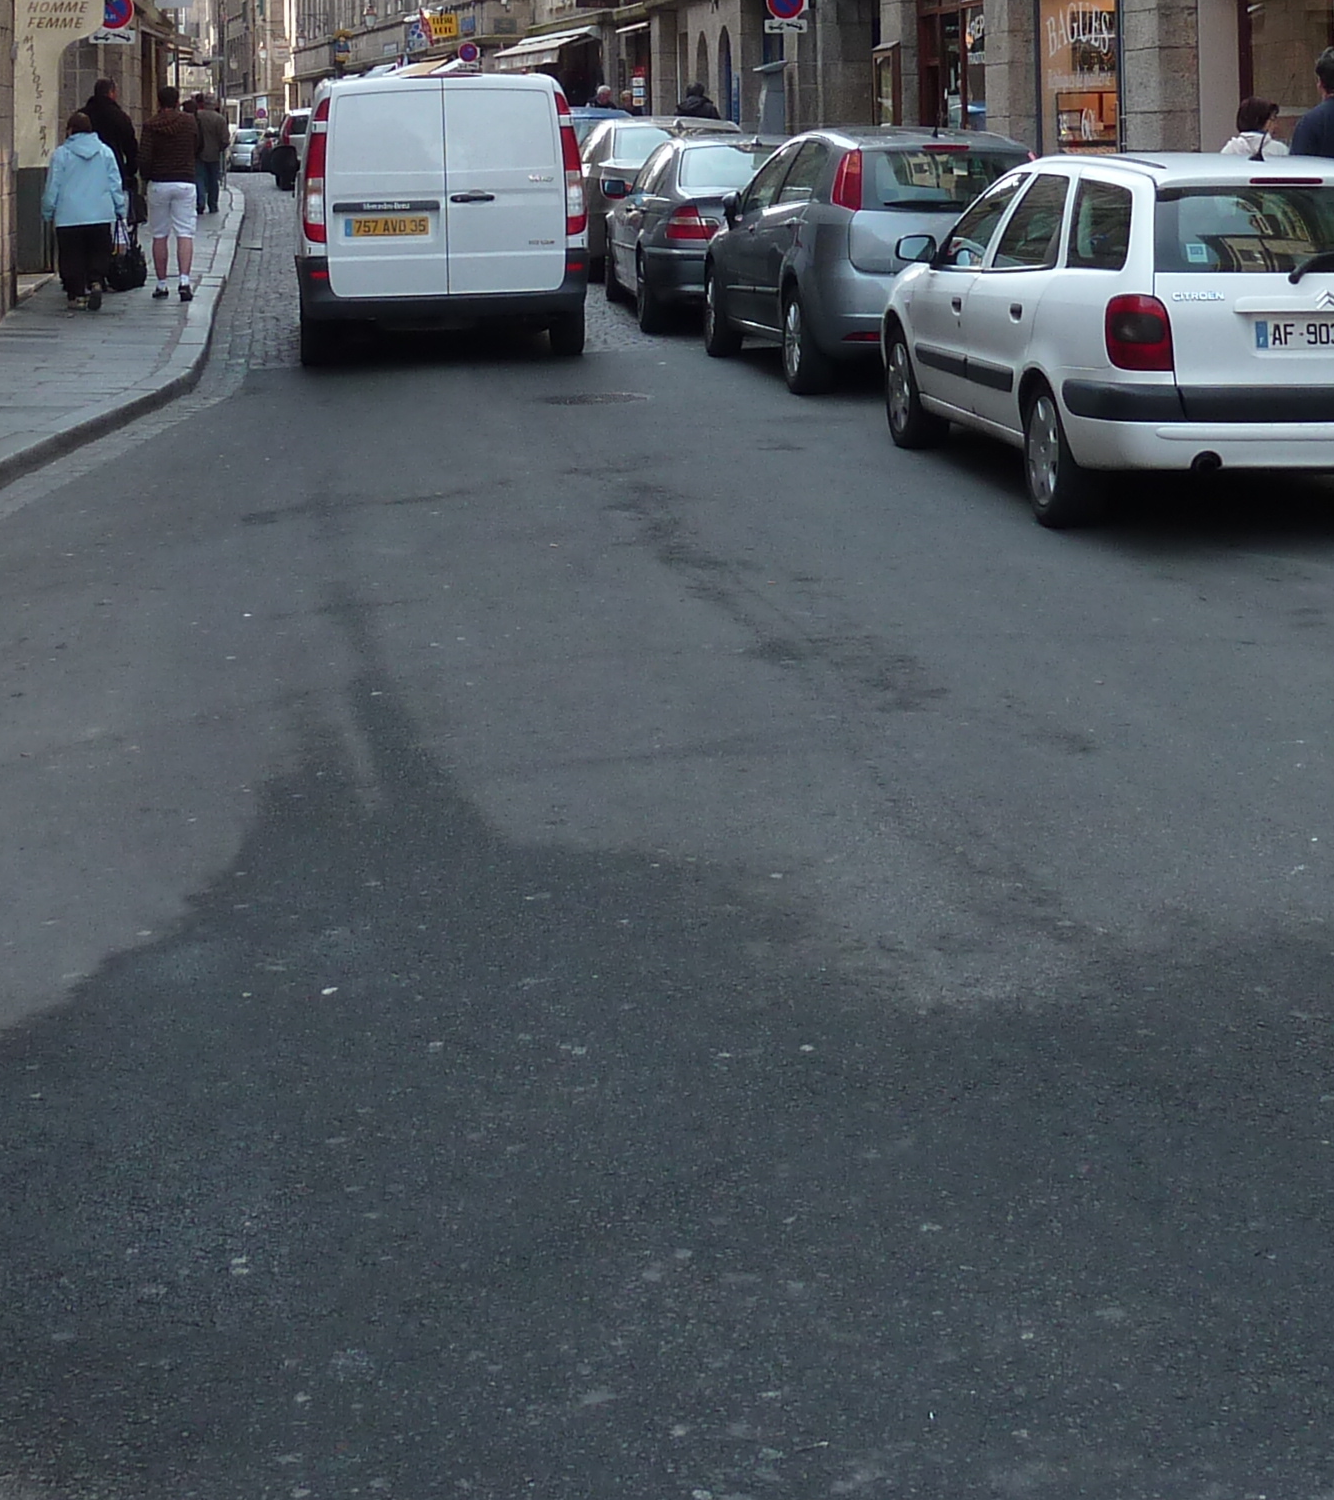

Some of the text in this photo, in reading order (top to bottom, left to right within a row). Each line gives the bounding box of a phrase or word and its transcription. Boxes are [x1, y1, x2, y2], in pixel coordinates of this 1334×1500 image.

[28, 1, 89, 14] HOMME
[27, 17, 85, 29] FEMME
[1046, 1, 1110, 58] BAGUES
[355, 220, 380, 234] 757
[410, 218, 427, 232] 35
